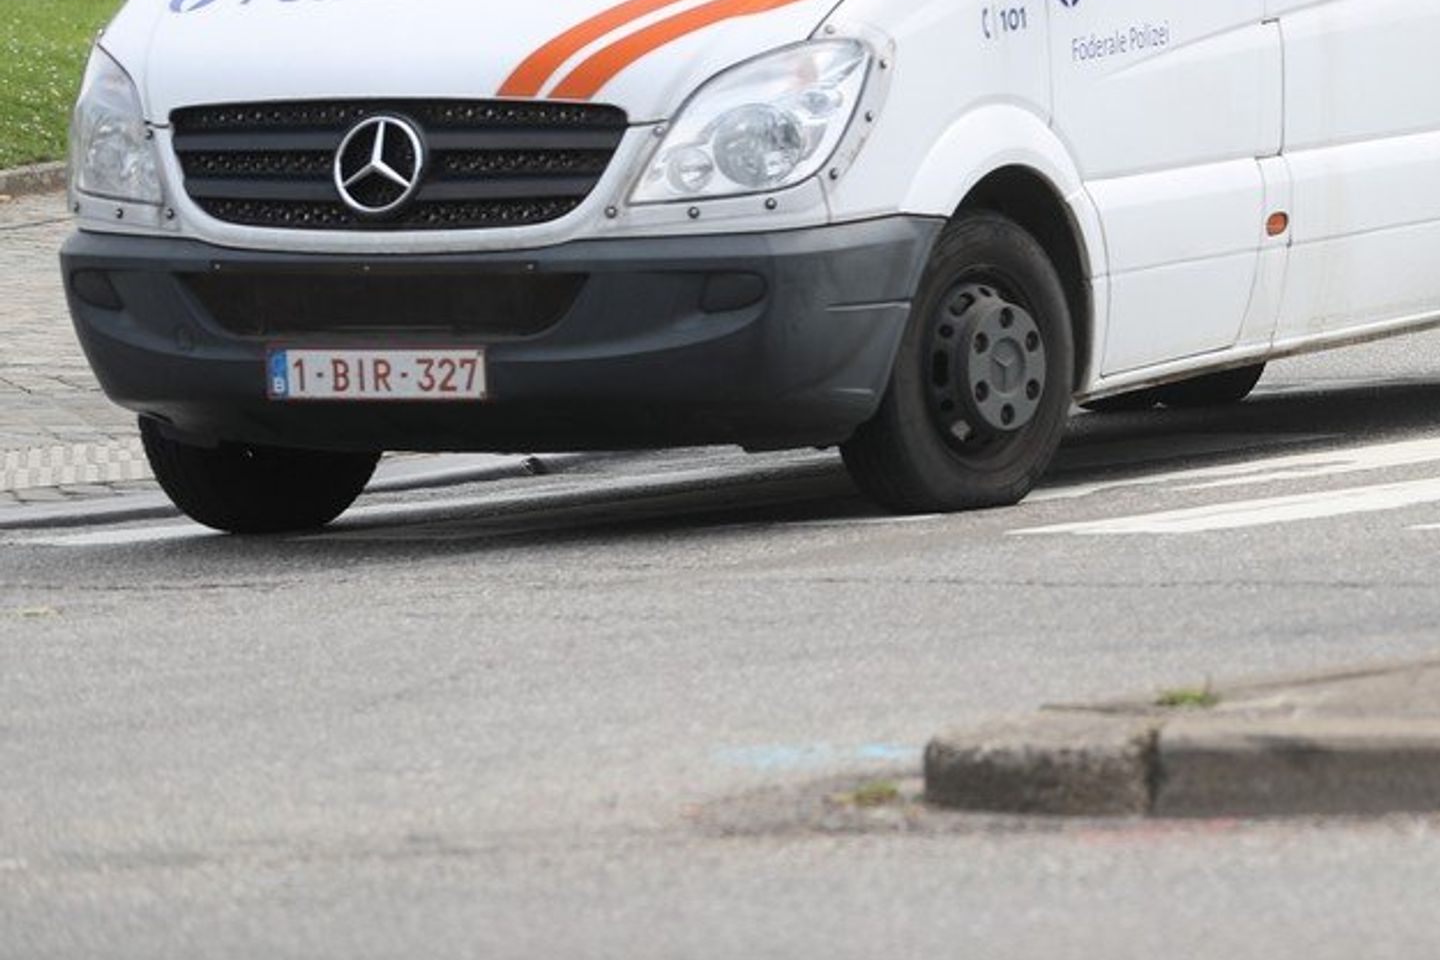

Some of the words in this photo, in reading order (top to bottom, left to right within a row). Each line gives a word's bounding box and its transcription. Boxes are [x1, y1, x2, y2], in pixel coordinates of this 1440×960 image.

[1000, 6, 1027, 32] 101
[1071, 29, 1128, 61] Föderale
[1130, 20, 1170, 53] Polizei
[293, 358, 478, 392] 1-BIR-327
